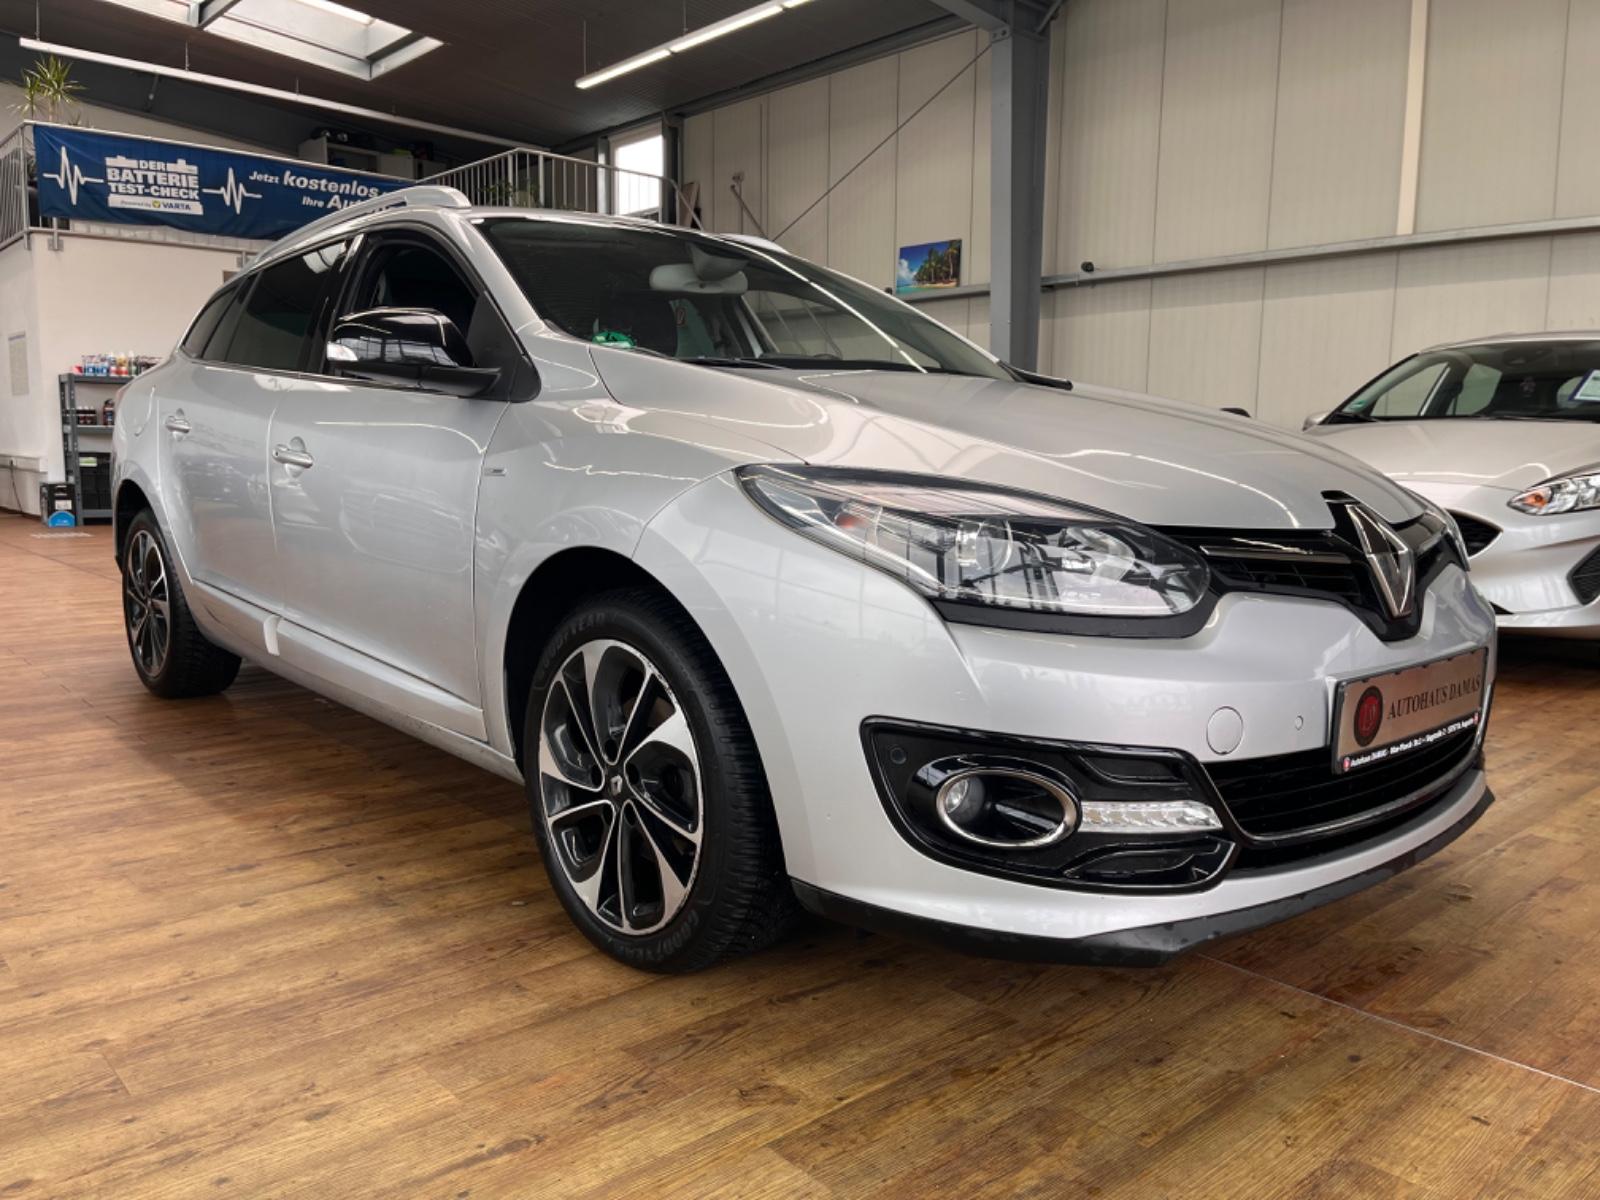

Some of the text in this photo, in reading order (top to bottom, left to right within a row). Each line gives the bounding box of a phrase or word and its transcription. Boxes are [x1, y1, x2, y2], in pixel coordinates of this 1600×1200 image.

[139, 160, 166, 171] DER
[107, 167, 199, 189] BATTERIE
[249, 170, 380, 198] Jetzt kostenlos
[107, 182, 200, 200] TEST-CHECK
[162, 202, 191, 210] VARTA
[302, 196, 325, 208] Ihre
[1387, 684, 1447, 719] AUTOHAUS
[1448, 674, 1481, 700] DAMAS
